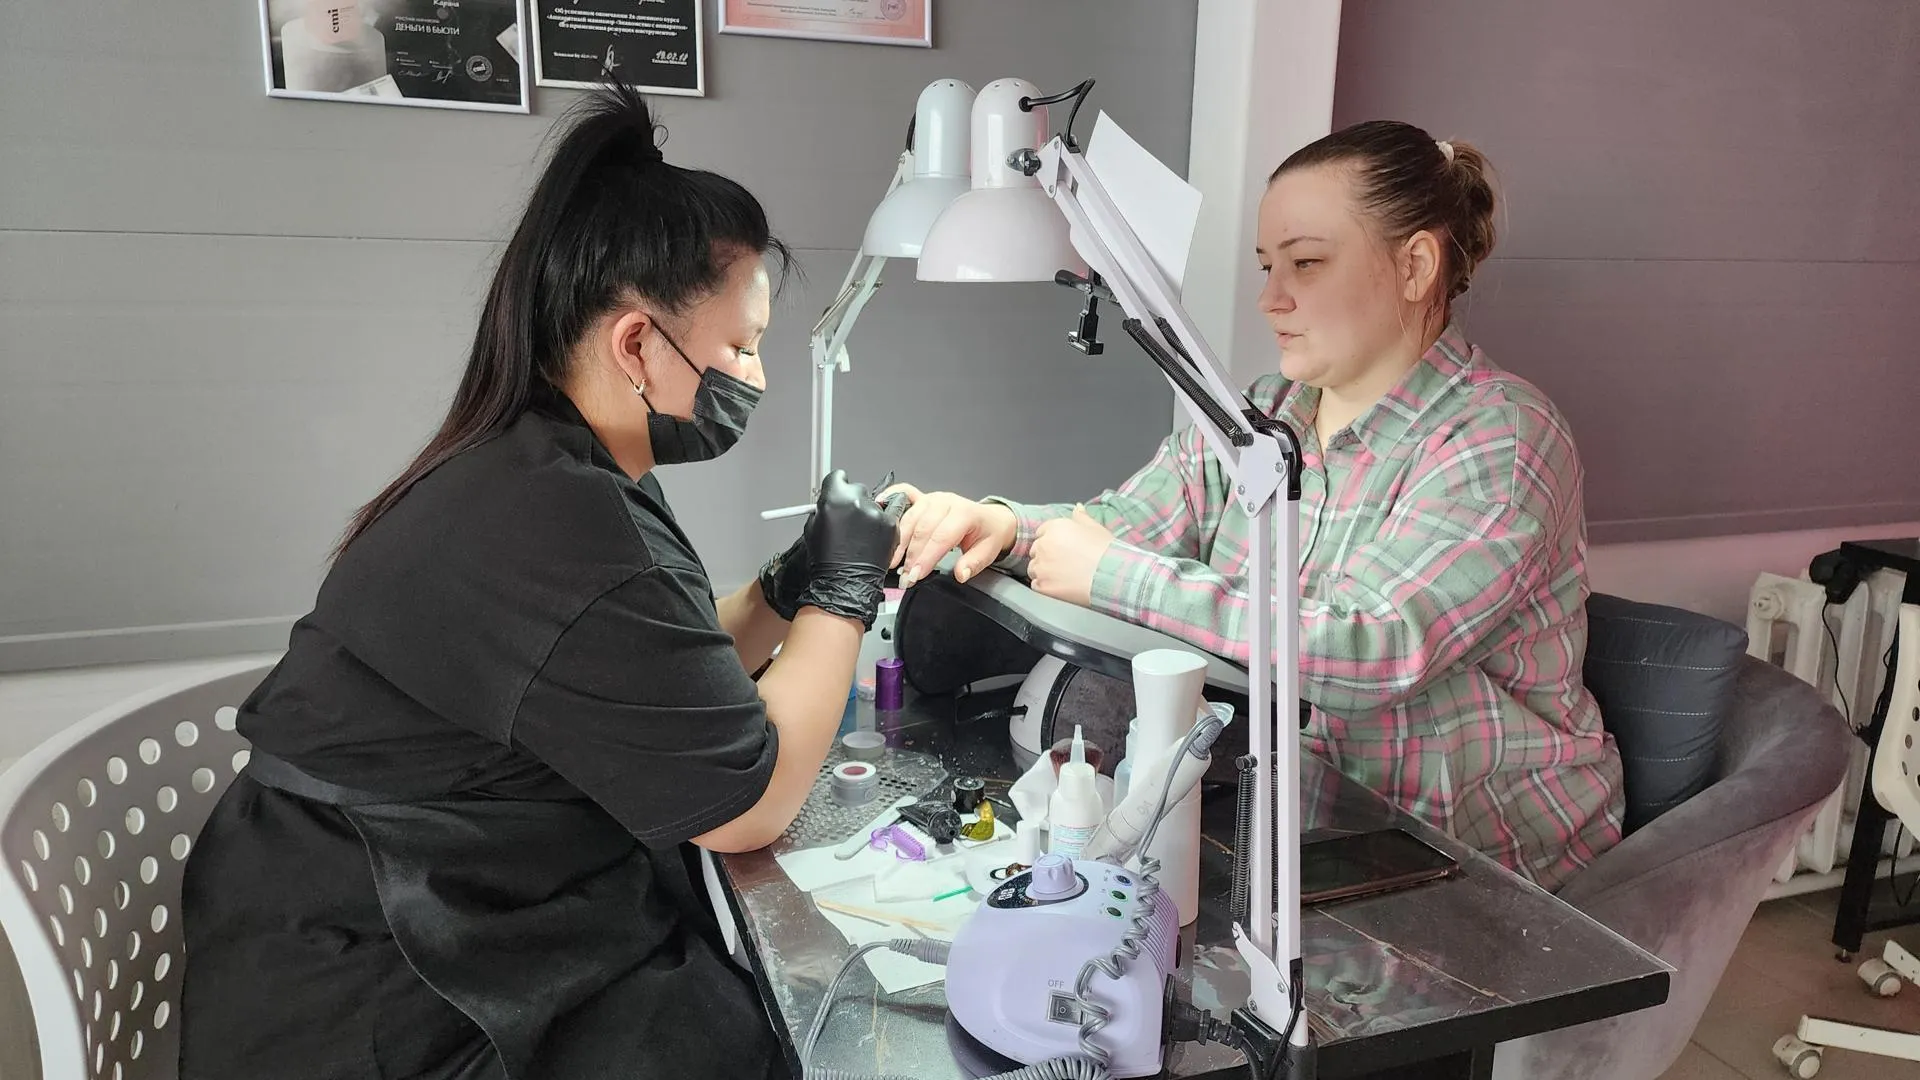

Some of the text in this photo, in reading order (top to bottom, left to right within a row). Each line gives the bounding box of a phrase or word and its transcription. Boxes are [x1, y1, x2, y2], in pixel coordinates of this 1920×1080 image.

[395, 23, 425, 33] ДЕНЬГИ
[432, 26, 460, 35] БЬЮТИ
[1047, 979, 1065, 989] OFF
